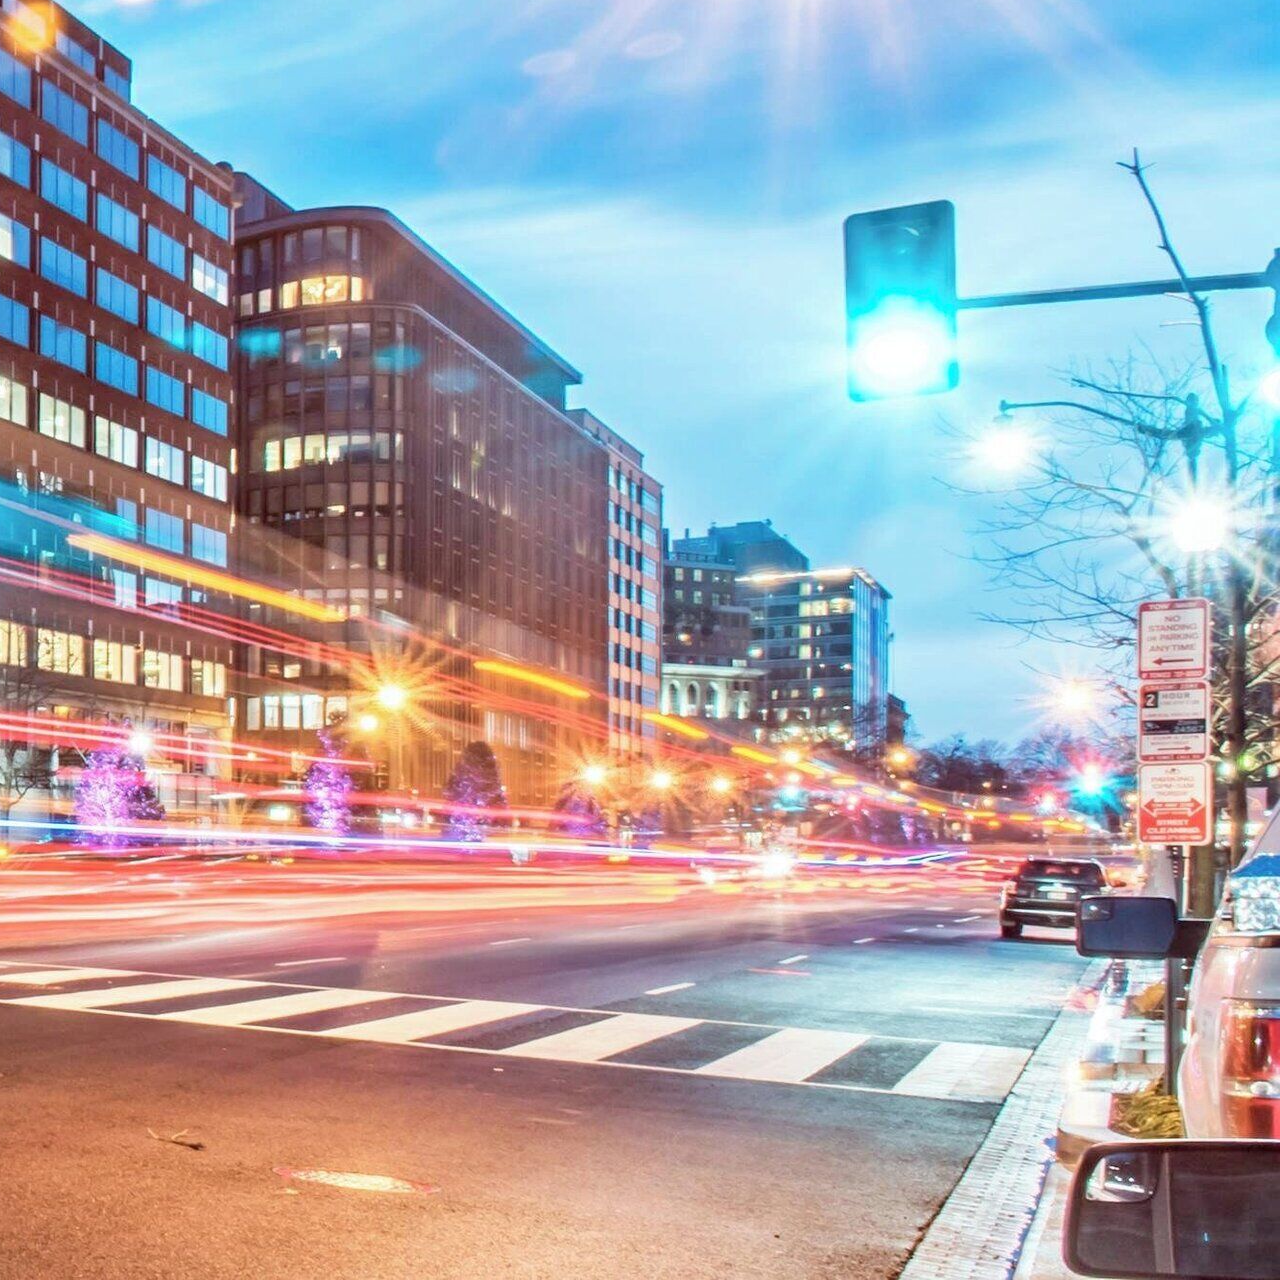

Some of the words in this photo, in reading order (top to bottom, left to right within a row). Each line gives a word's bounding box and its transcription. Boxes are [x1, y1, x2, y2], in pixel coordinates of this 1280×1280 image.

[1148, 623, 1197, 632] STANDING
[1159, 632, 1199, 641] PARKING
[1149, 643, 1195, 652] ANYTIME
[1146, 693, 1156, 707] 2
